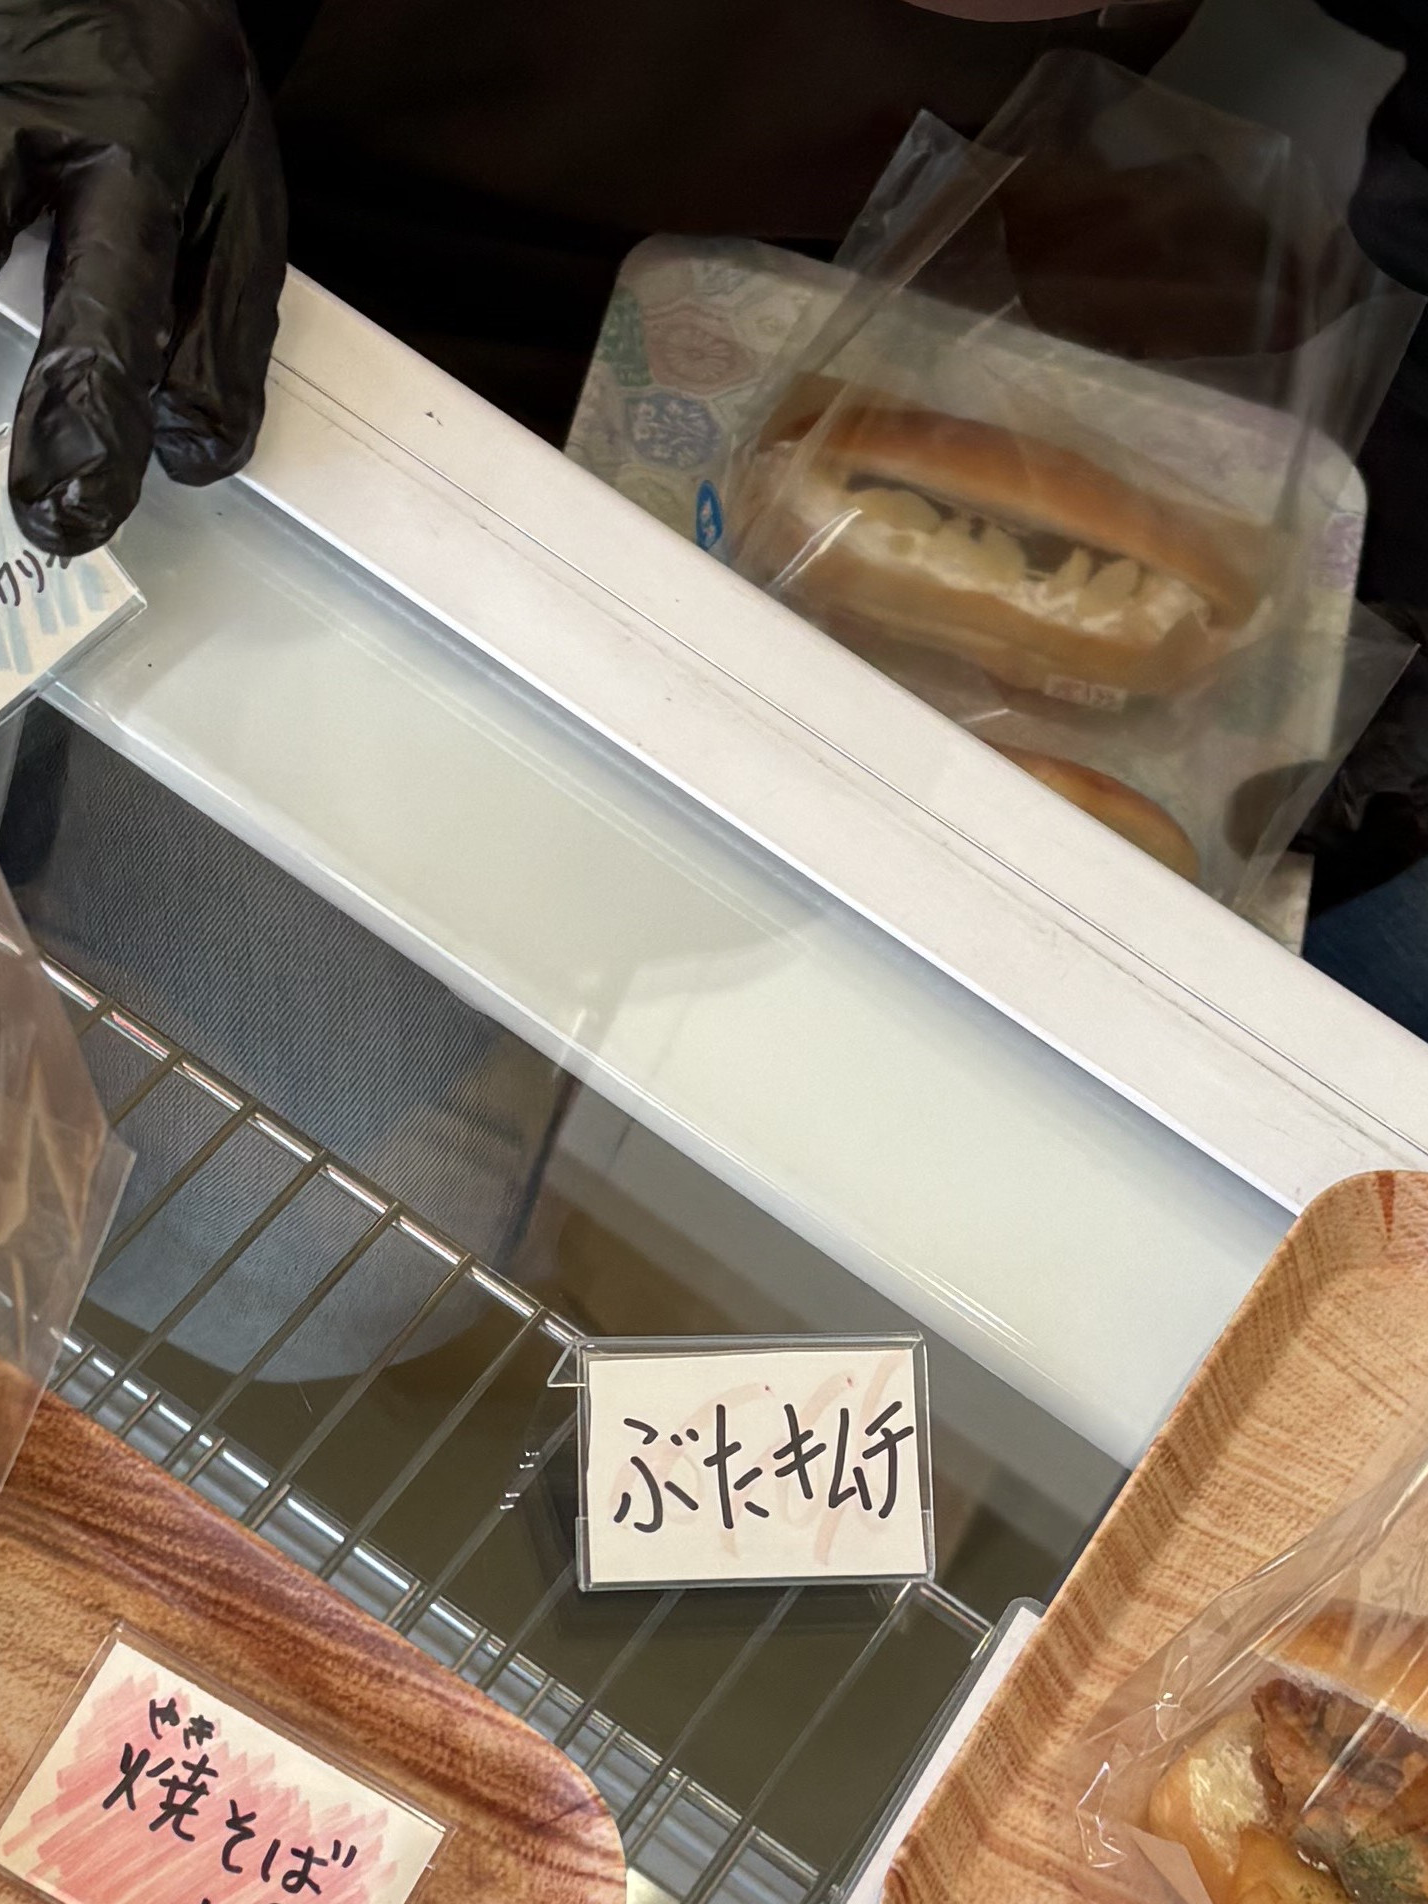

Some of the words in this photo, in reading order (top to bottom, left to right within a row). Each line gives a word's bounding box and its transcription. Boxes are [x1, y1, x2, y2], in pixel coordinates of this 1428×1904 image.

[612, 1400, 915, 1534] ぶたキムチ
[102, 1742, 359, 1896] 焼そば
